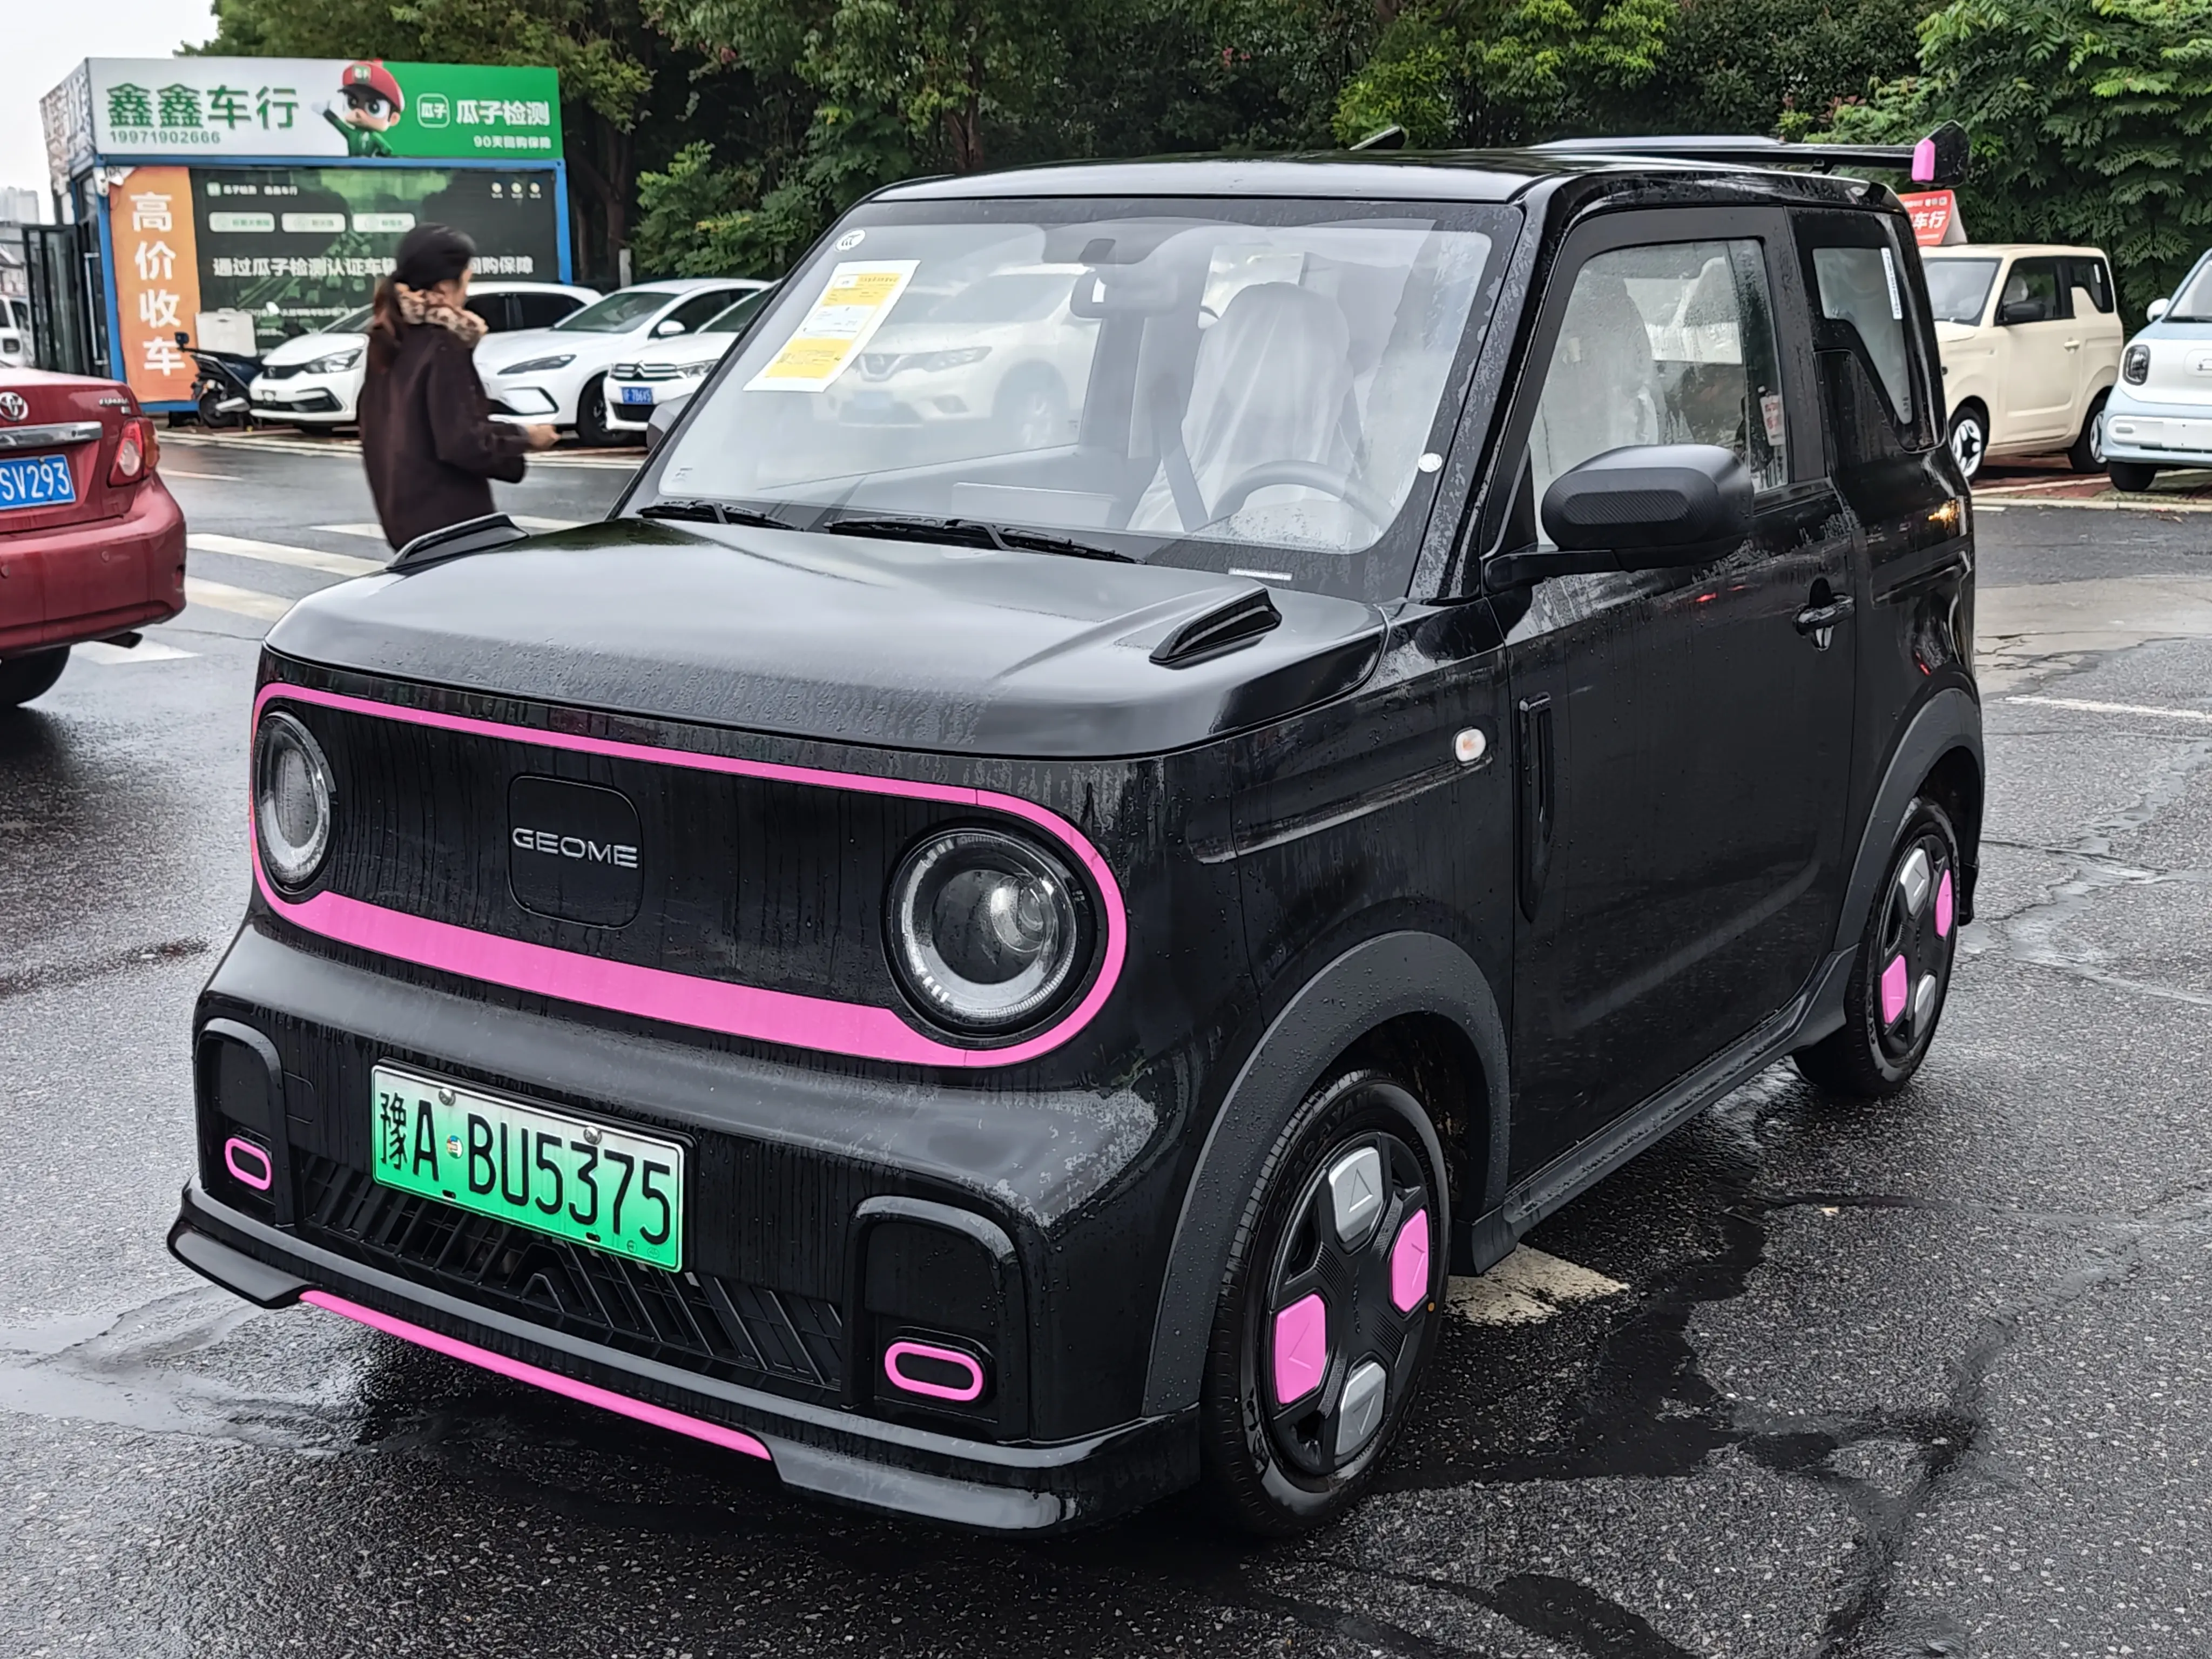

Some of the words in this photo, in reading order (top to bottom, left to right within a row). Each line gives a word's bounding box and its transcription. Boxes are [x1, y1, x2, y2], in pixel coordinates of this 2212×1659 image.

[106, 83, 300, 130] 鑫鑫车行
[421, 102, 447, 119] 瓜子
[456, 99, 550, 126] 瓜子检测
[110, 130, 221, 144] 19971902666
[1910, 210, 1946, 230] 车行
[130, 191, 186, 376] 高价收车
[0, 462, 70, 501] SV293
[513, 828, 638, 868] GEOME
